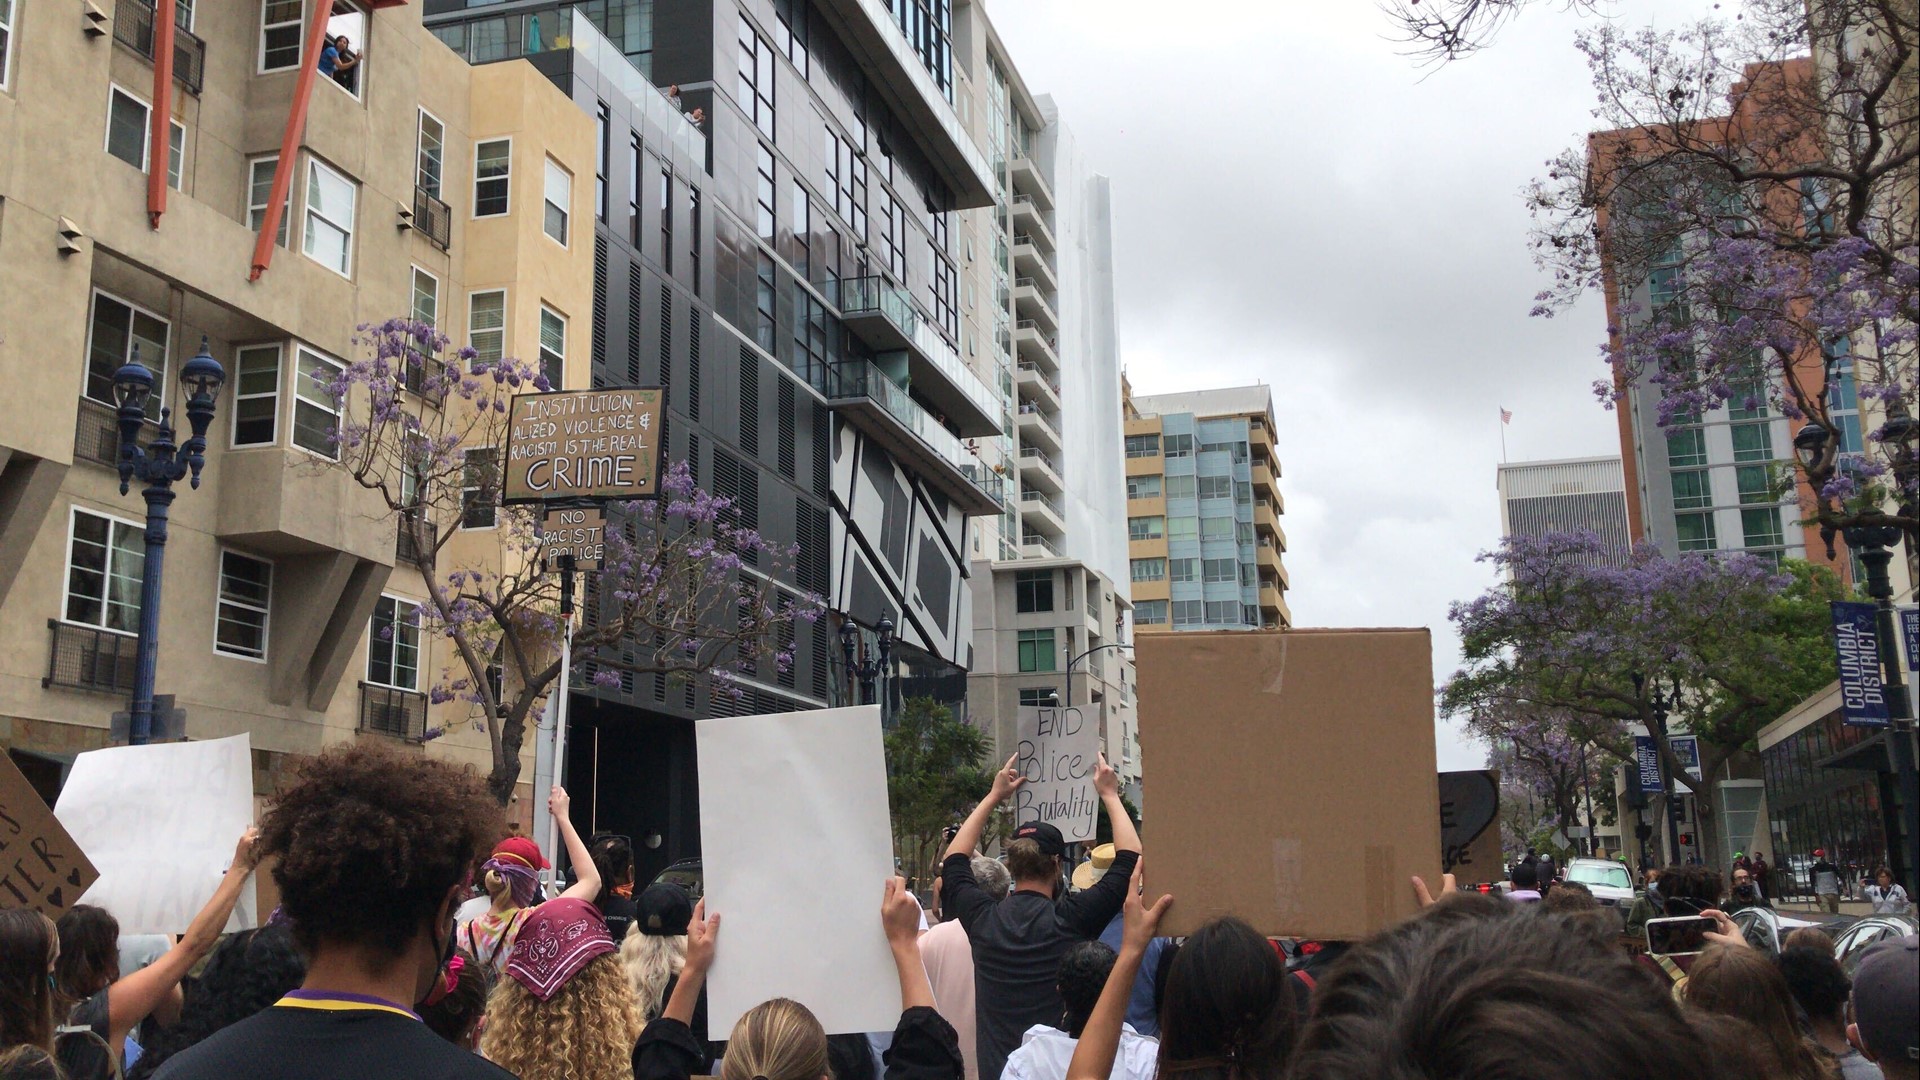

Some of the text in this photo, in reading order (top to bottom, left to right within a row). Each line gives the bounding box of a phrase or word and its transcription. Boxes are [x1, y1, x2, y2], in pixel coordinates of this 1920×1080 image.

[523, 394, 645, 421] INSTITUTION-
[512, 411, 651, 441] ALIZED VIOLENCE &
[510, 434, 648, 461] RACISM IS THE REAL
[526, 455, 647, 492] CRIME.
[560, 510, 586, 525] NO
[542, 527, 600, 546] RACIST
[1836, 622, 1865, 709] COLUMBIA
[1855, 628, 1884, 704] DISTRICT
[1037, 707, 1083, 738] END
[1018, 740, 1088, 783] Police
[1637, 745, 1651, 786] COLUMBIA
[1647, 749, 1660, 783] DISTRICT
[1016, 785, 1095, 838] Brutality
